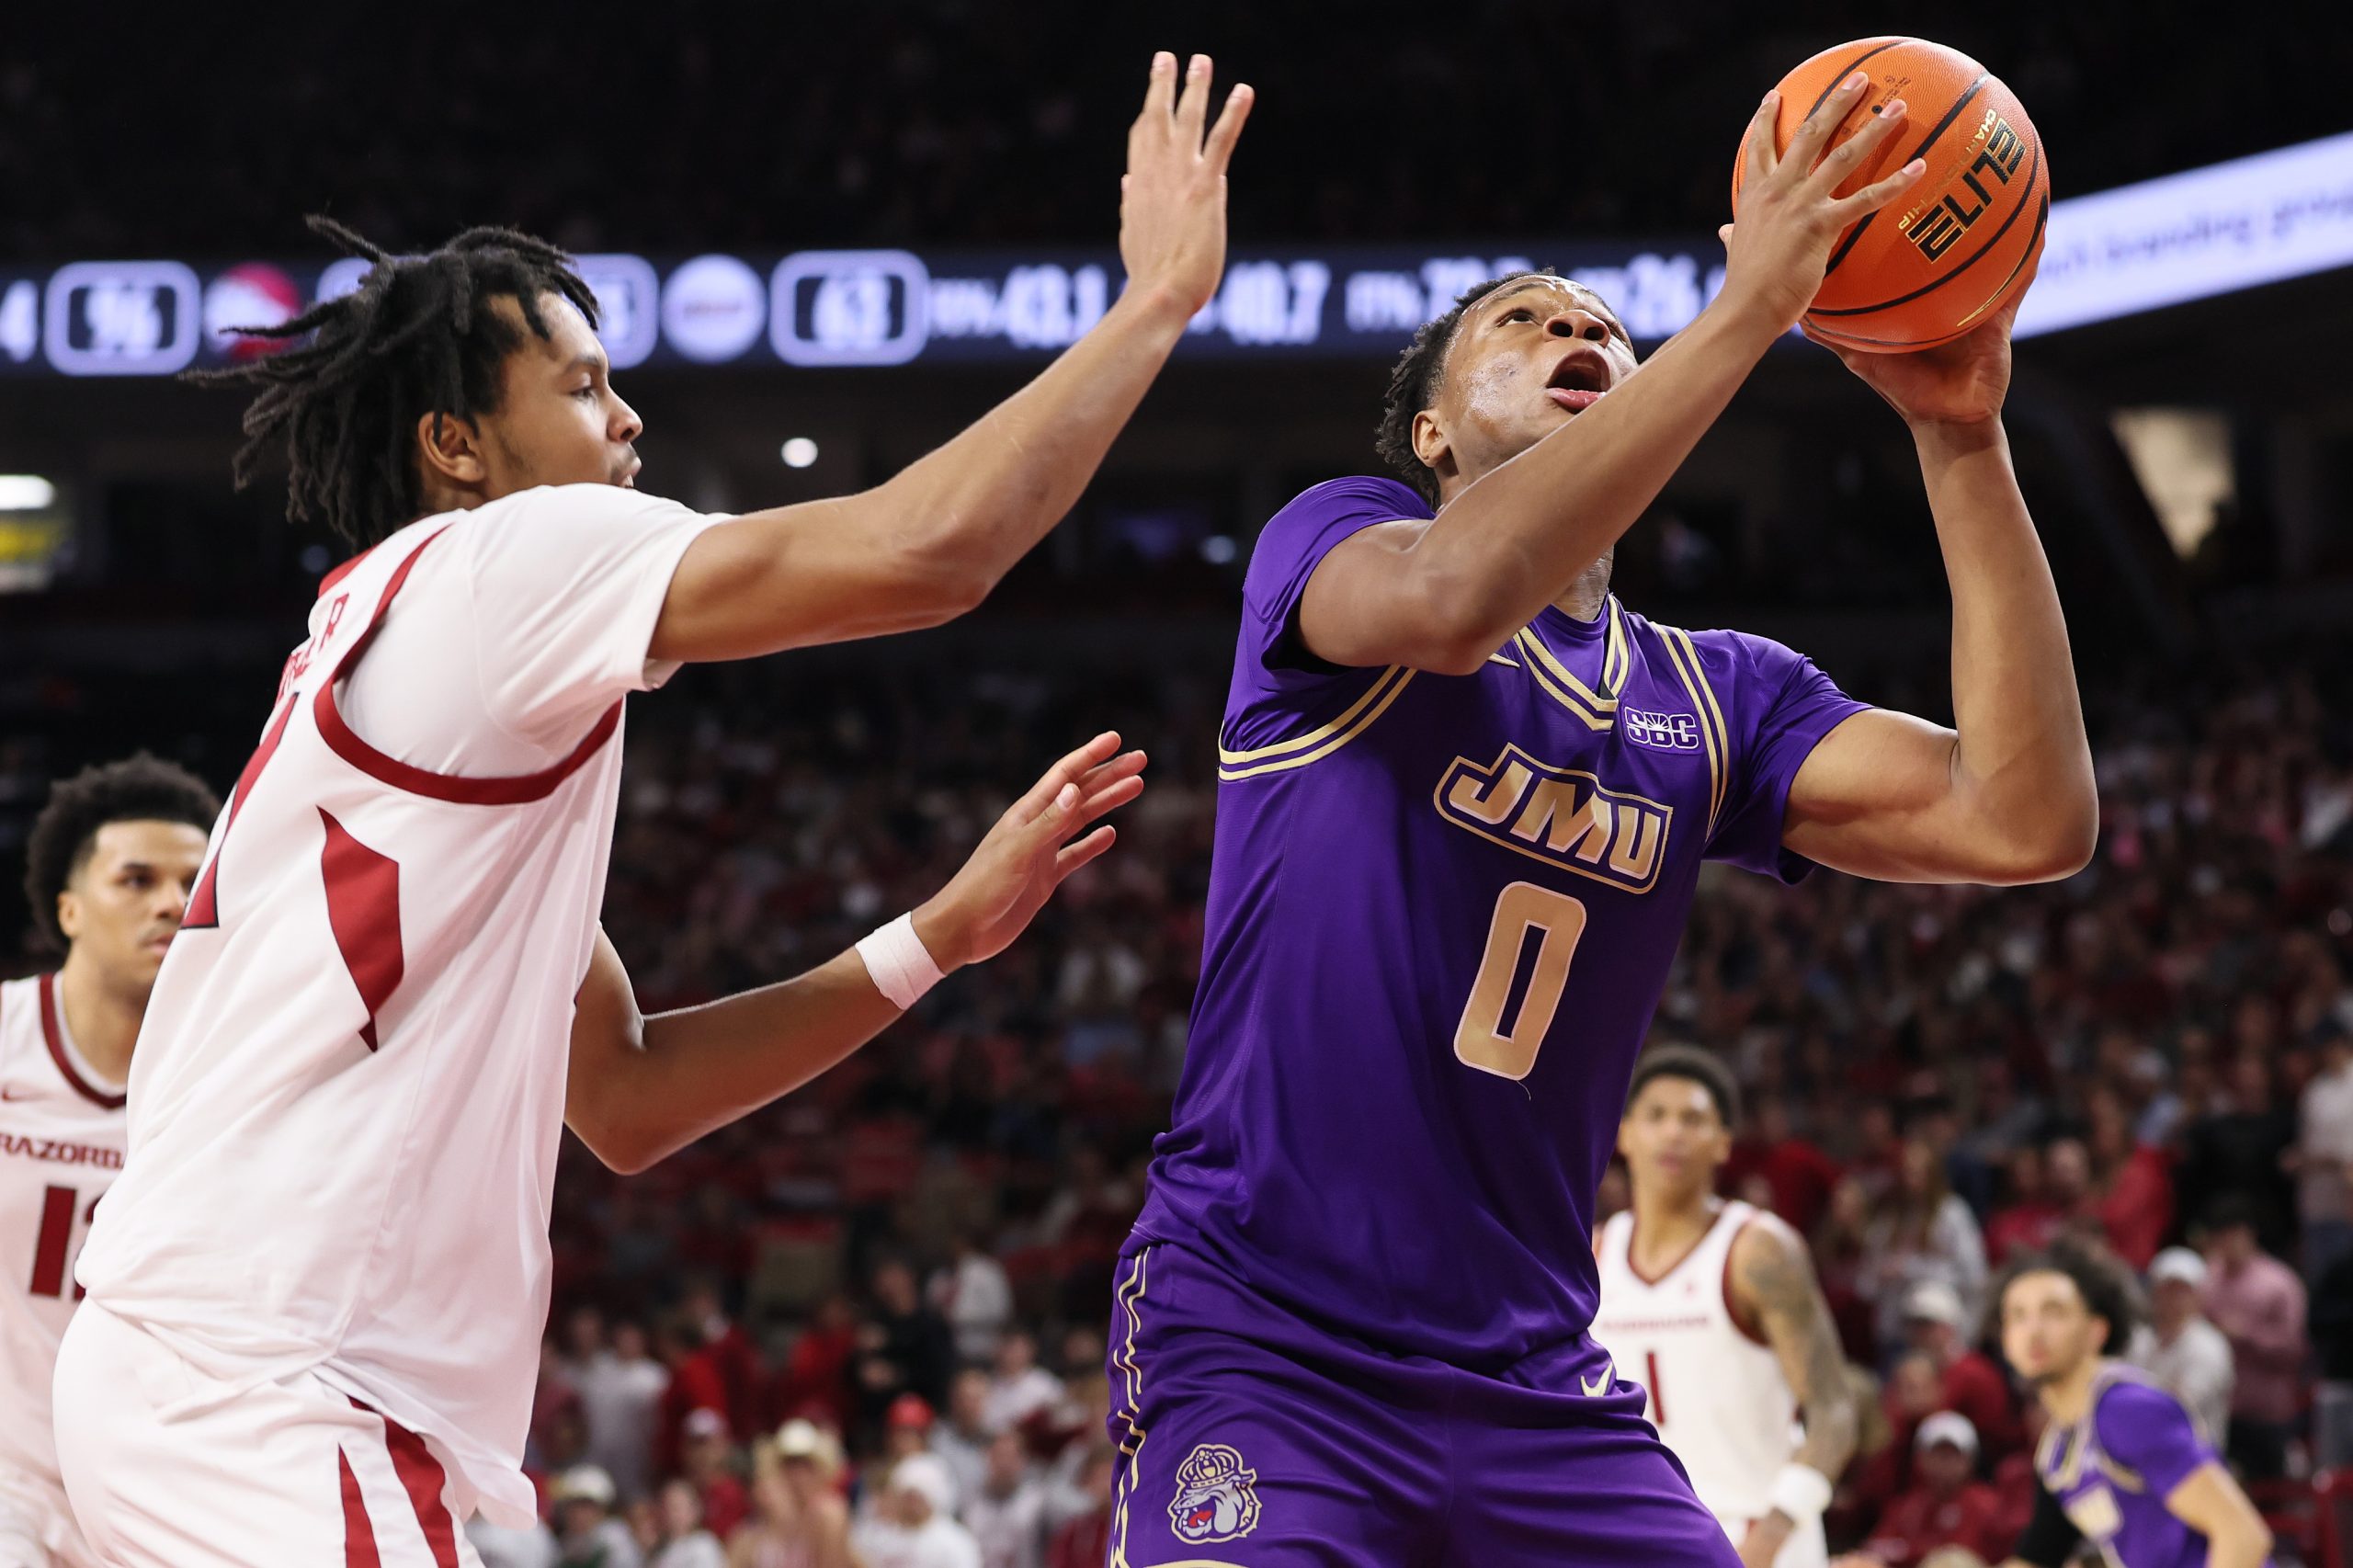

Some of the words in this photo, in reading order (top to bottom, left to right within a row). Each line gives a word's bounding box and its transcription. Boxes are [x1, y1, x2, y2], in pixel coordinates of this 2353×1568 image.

[1905, 118, 2028, 264] ELITE
[1625, 707, 1699, 749] SBC
[1445, 756, 1665, 882] JMU
[1454, 881, 1586, 1081] 0
[29, 1183, 104, 1301] 1
[1647, 1351, 1665, 1424] 1
